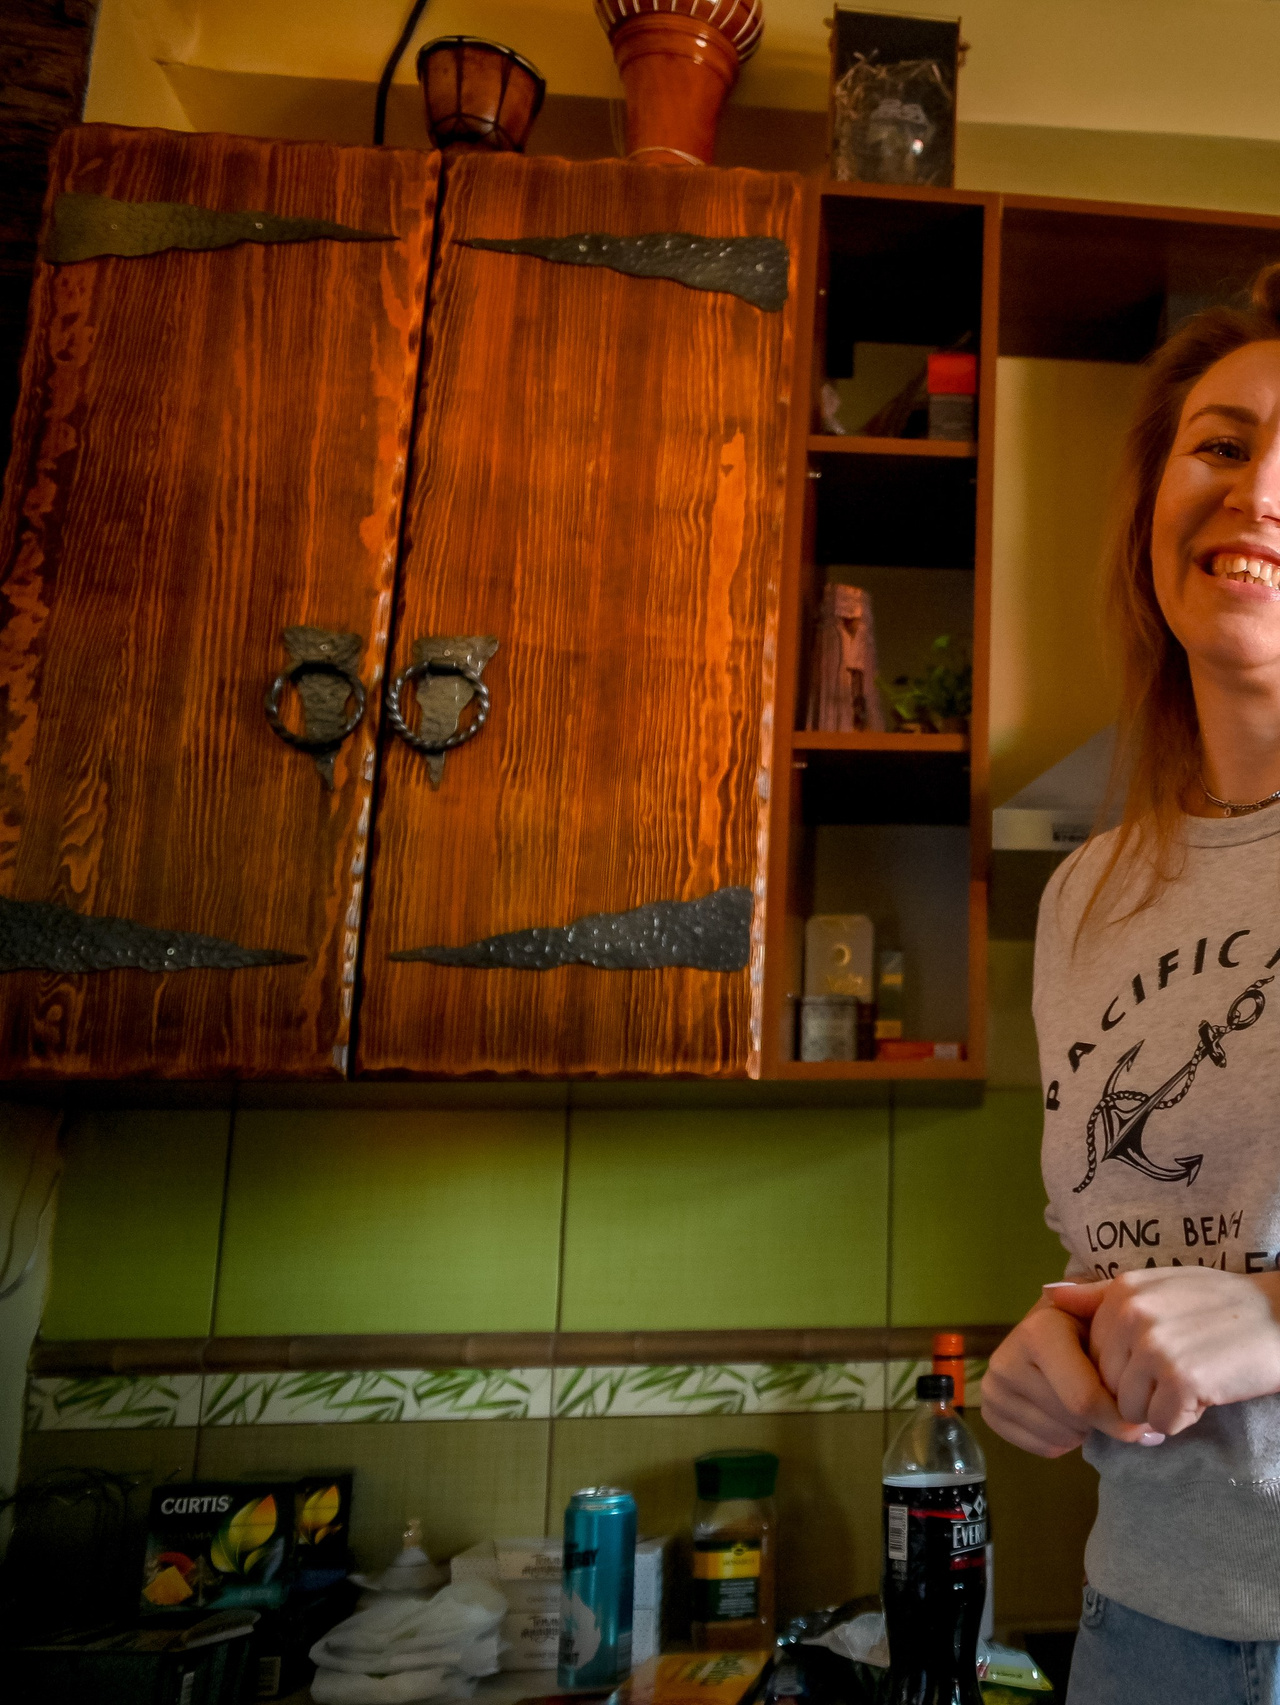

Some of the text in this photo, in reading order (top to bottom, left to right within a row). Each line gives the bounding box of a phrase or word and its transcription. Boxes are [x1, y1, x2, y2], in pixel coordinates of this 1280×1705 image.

[1045, 929, 1251, 1111] PACIFIC
[1086, 1218, 1161, 1253] LONG
[160, 1494, 230, 1515] CURTIS
